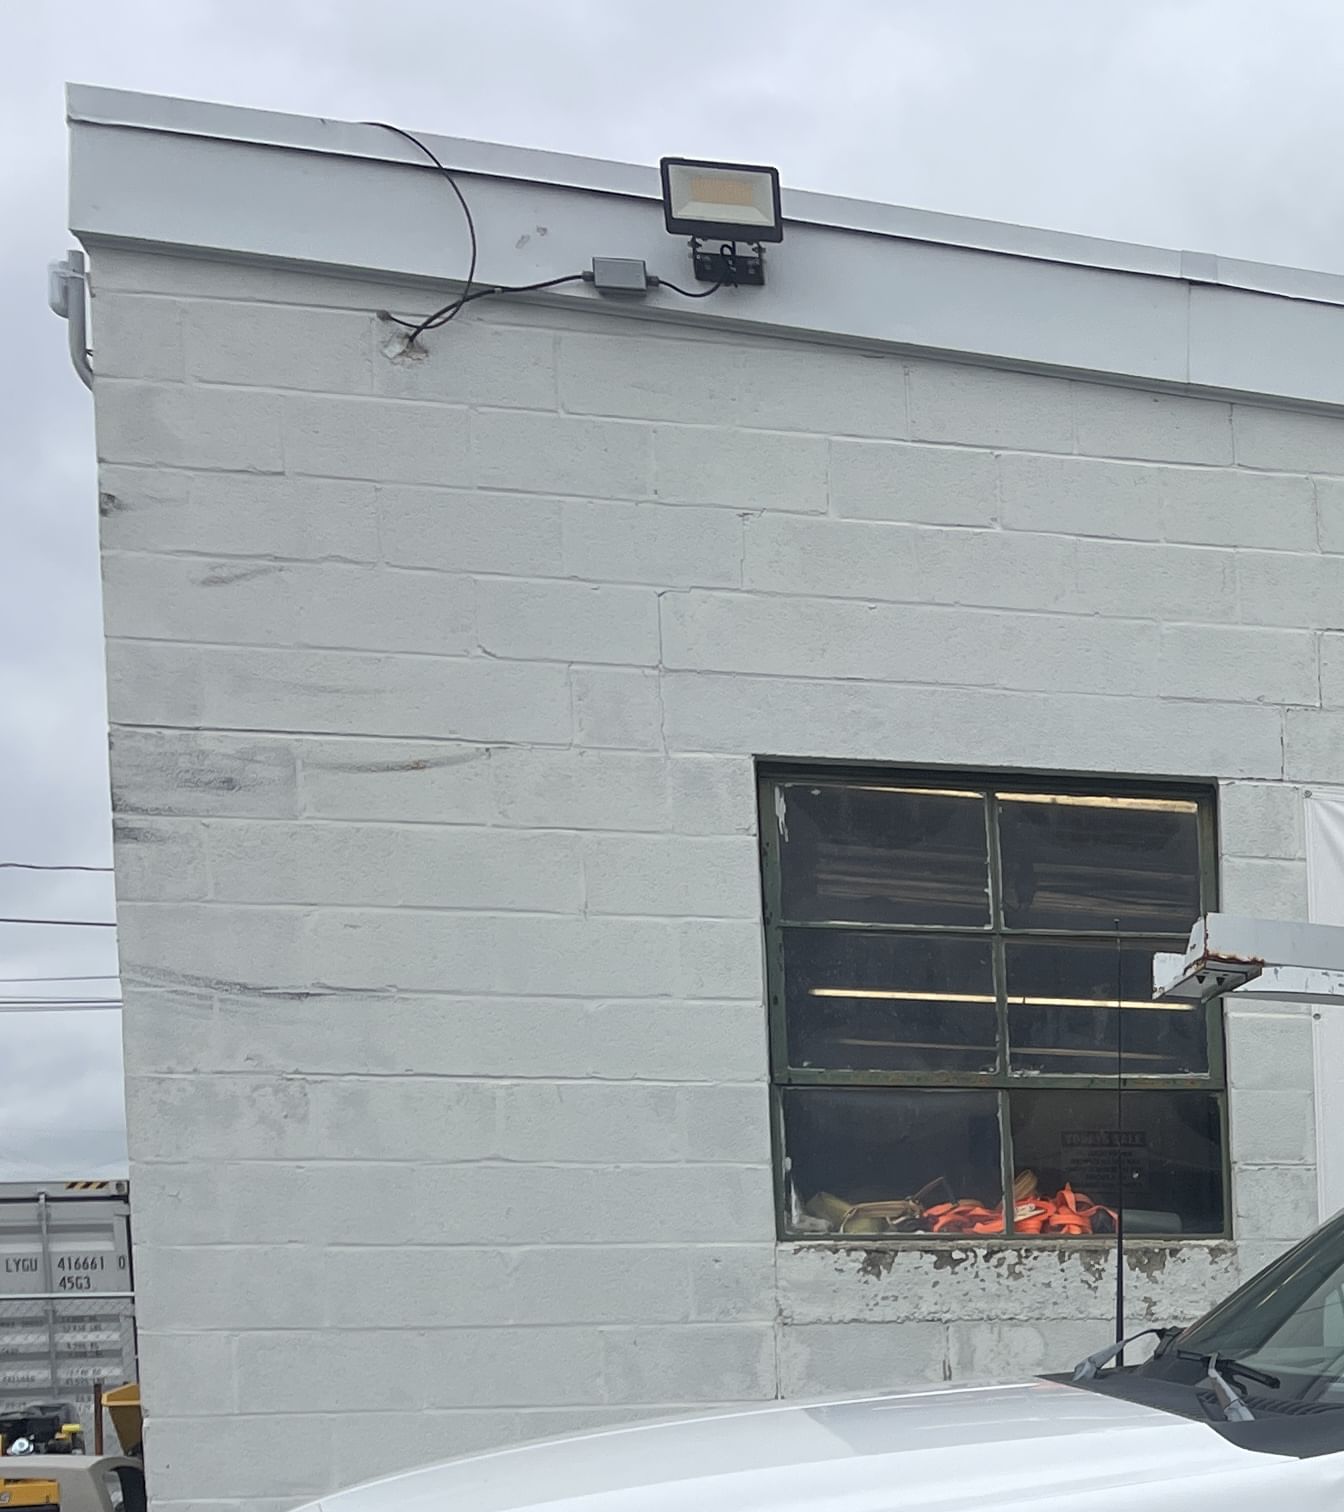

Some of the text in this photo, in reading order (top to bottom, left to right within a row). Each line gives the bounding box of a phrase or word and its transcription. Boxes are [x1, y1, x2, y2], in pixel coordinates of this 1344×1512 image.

[5, 1257, 39, 1273] LYGU
[57, 1256, 104, 1271] 416661
[59, 1275, 91, 1290] 45G3
